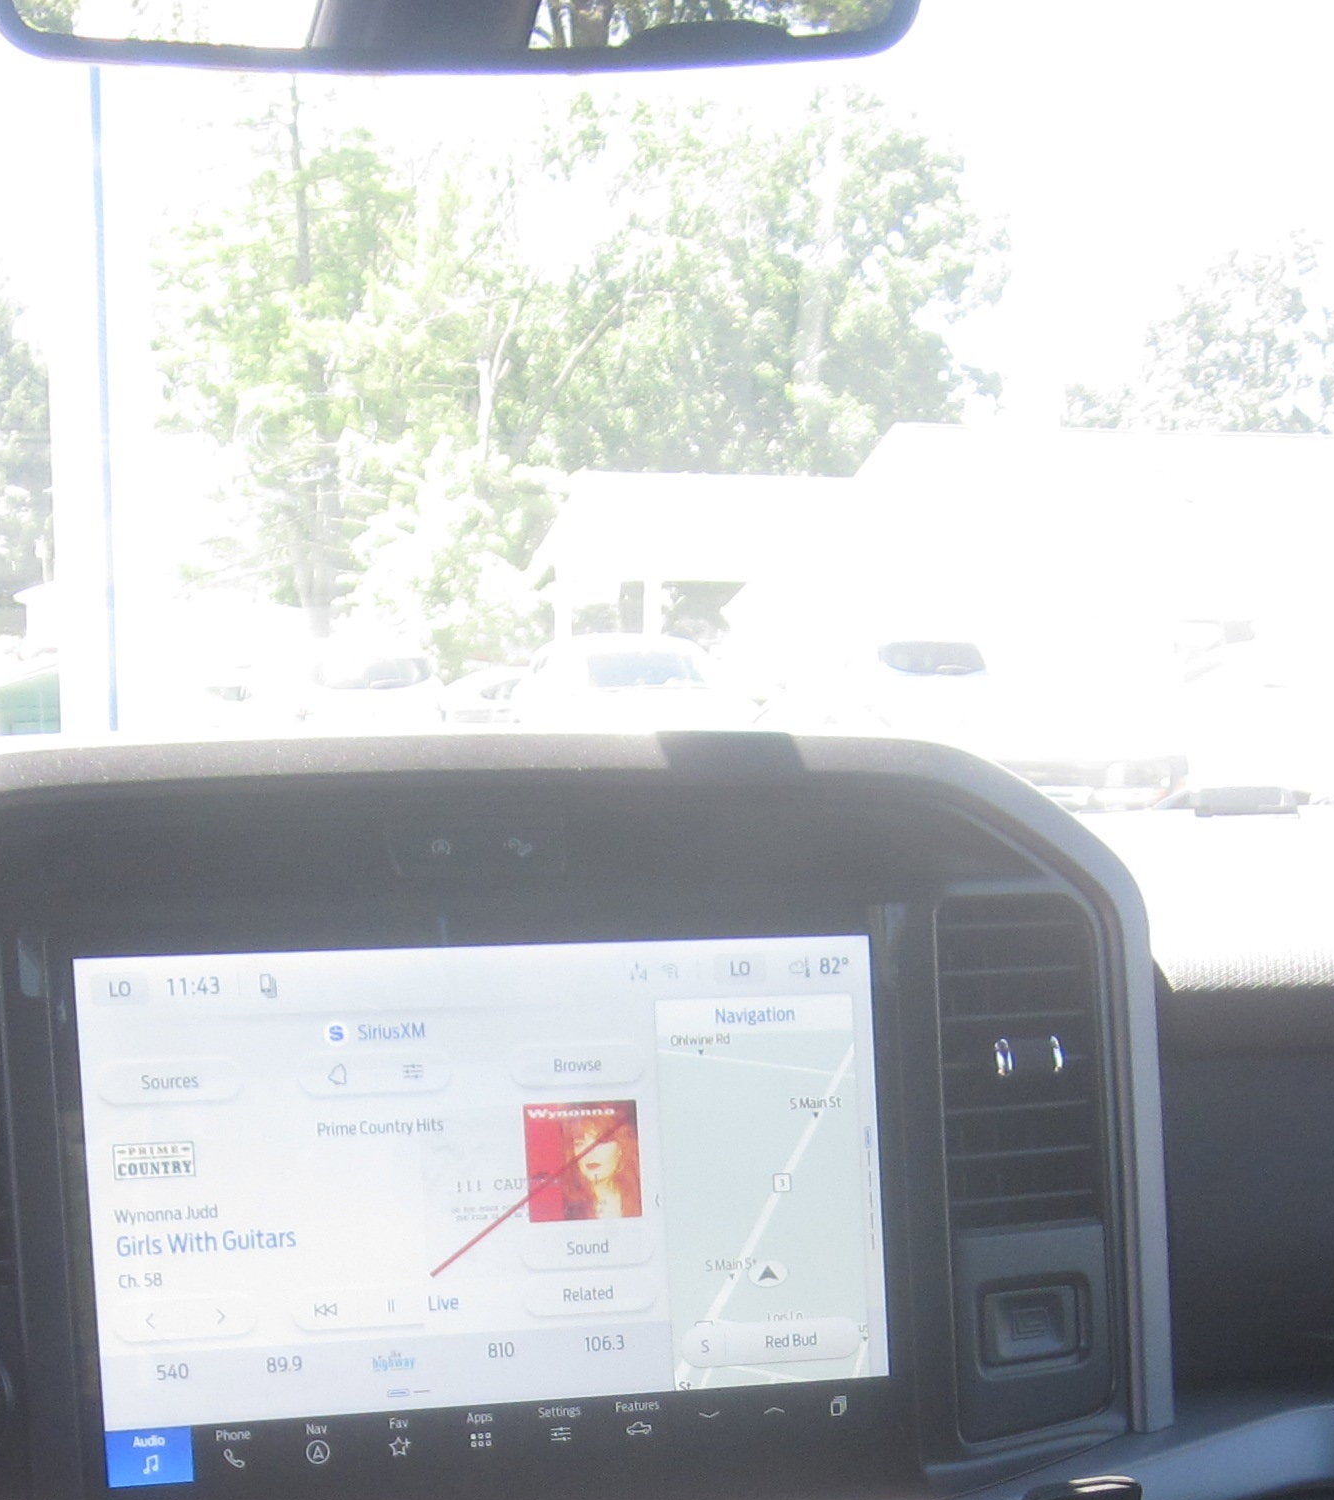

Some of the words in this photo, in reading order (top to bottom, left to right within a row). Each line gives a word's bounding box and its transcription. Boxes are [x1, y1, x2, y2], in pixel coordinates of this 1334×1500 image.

[730, 961, 750, 976] LO
[109, 981, 131, 998] LO
[166, 977, 220, 996] 11:43
[715, 1007, 795, 1025] Navigation
[358, 1022, 426, 1041] SiriusXM
[715, 1034, 730, 1045] Rd
[554, 1058, 601, 1073] Browse
[141, 1074, 199, 1090] Sources
[790, 1097, 797, 1109] S
[799, 1097, 825, 1108] Main
[828, 1096, 841, 1108] St
[528, 1106, 615, 1121] Wynonna
[317, 1122, 357, 1138] Prime
[359, 1119, 414, 1137] Country
[417, 1119, 444, 1133] Hits
[128, 1144, 179, 1155] PRIME
[118, 1160, 191, 1176] COUNTRY
[114, 1208, 182, 1225] Wynonna
[185, 1205, 218, 1219] Judd
[116, 1235, 162, 1257] Girls
[166, 1231, 218, 1254] With
[222, 1229, 297, 1251] Guitars
[566, 1241, 609, 1255] Sound
[705, 1260, 712, 1272] S
[715, 1259, 742, 1271] Main
[144, 1273, 162, 1287] 58
[562, 1287, 614, 1302] Related
[428, 1296, 459, 1311] Live
[585, 1335, 625, 1352] 106.3
[701, 1339, 710, 1353] S
[765, 1334, 789, 1349] Red
[793, 1332, 817, 1347] Bud
[488, 1342, 515, 1358] 810
[156, 1364, 189, 1380] 540
[266, 1356, 302, 1373] 89.9
[538, 1405, 581, 1419] Settings
[615, 1400, 660, 1414] Features
[389, 1417, 408, 1430] Fav
[467, 1412, 493, 1425] Apps
[215, 1428, 251, 1442] Phone
[306, 1424, 327, 1436] Nav
[133, 1434, 166, 1448] Audio
